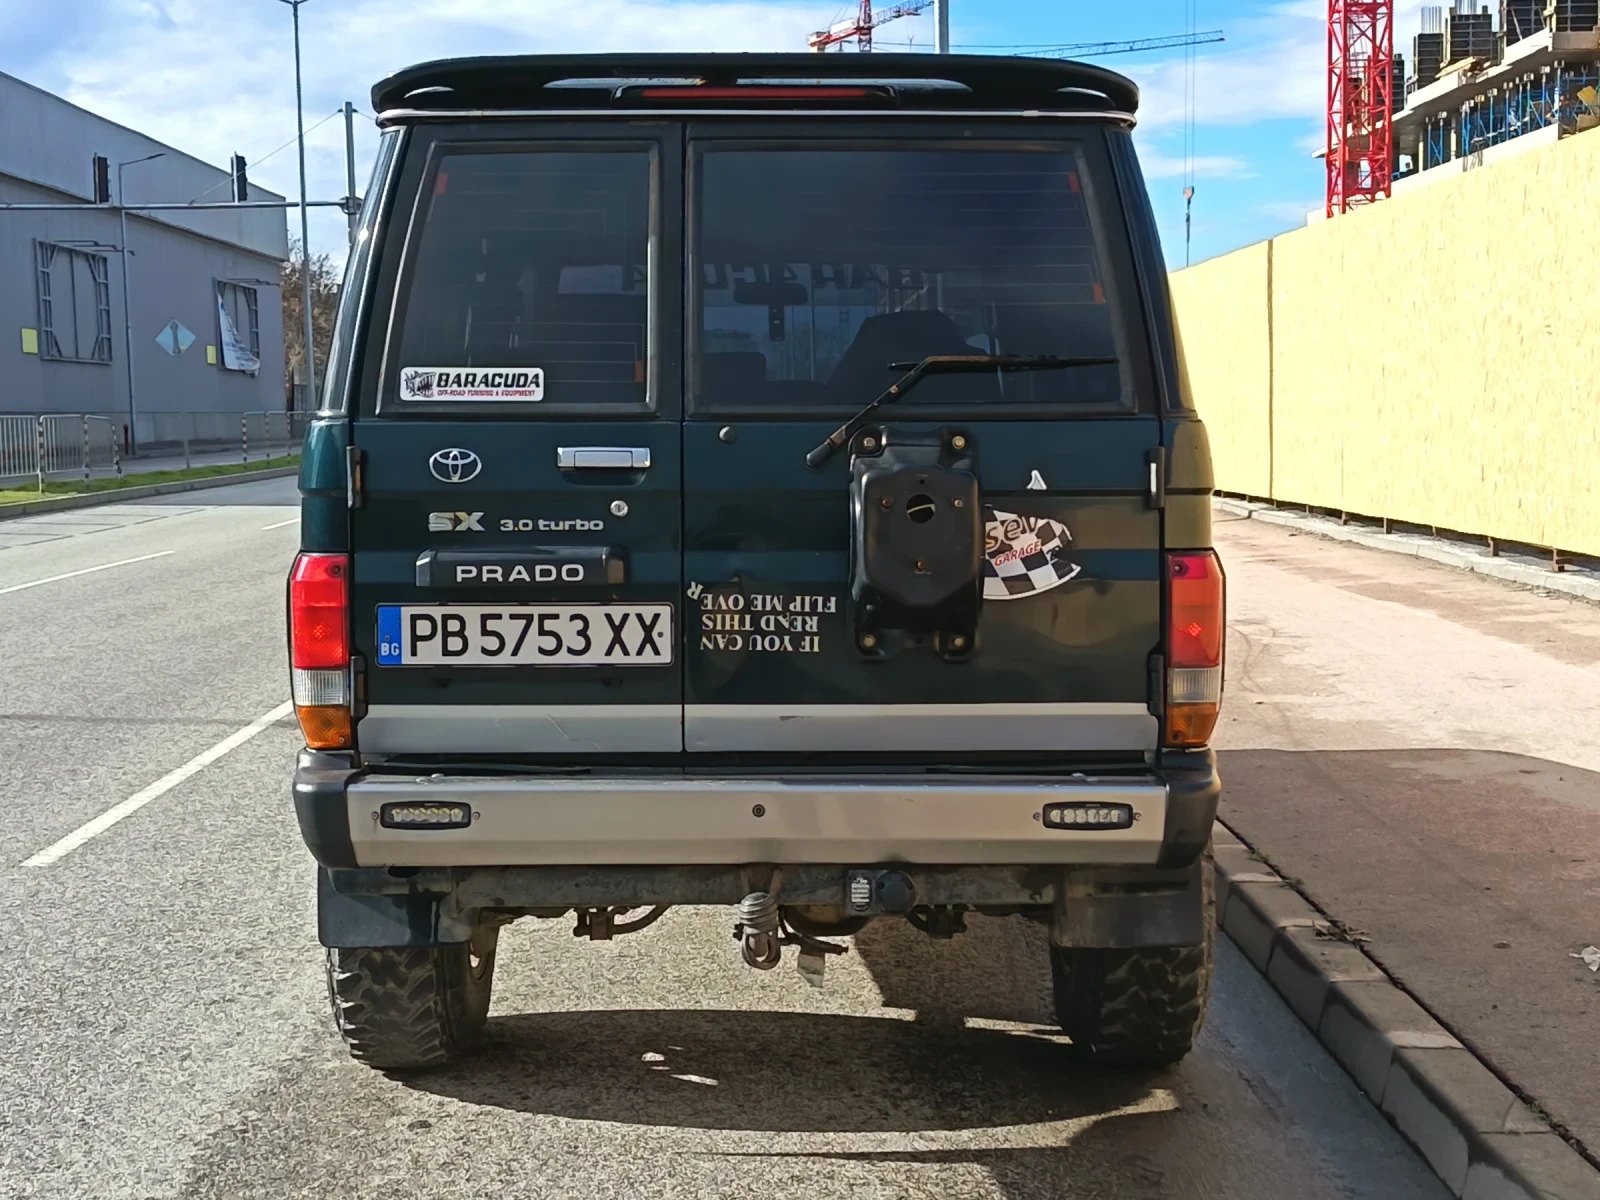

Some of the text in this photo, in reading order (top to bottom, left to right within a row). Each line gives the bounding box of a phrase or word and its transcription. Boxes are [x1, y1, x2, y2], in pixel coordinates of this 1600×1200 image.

[437, 373, 540, 388] BARACUDA
[428, 512, 486, 532] SX
[500, 519, 604, 531] 3.0 turbo
[994, 540, 1041, 567] GARAGE
[456, 564, 585, 582] PRADO
[750, 594, 784, 611] ME
[788, 595, 836, 613] FLIP
[701, 612, 819, 632] READ THIS
[409, 612, 661, 657] PB 5753 XX
[700, 634, 820, 652] IF YOU CAN
[380, 642, 400, 656] BG
